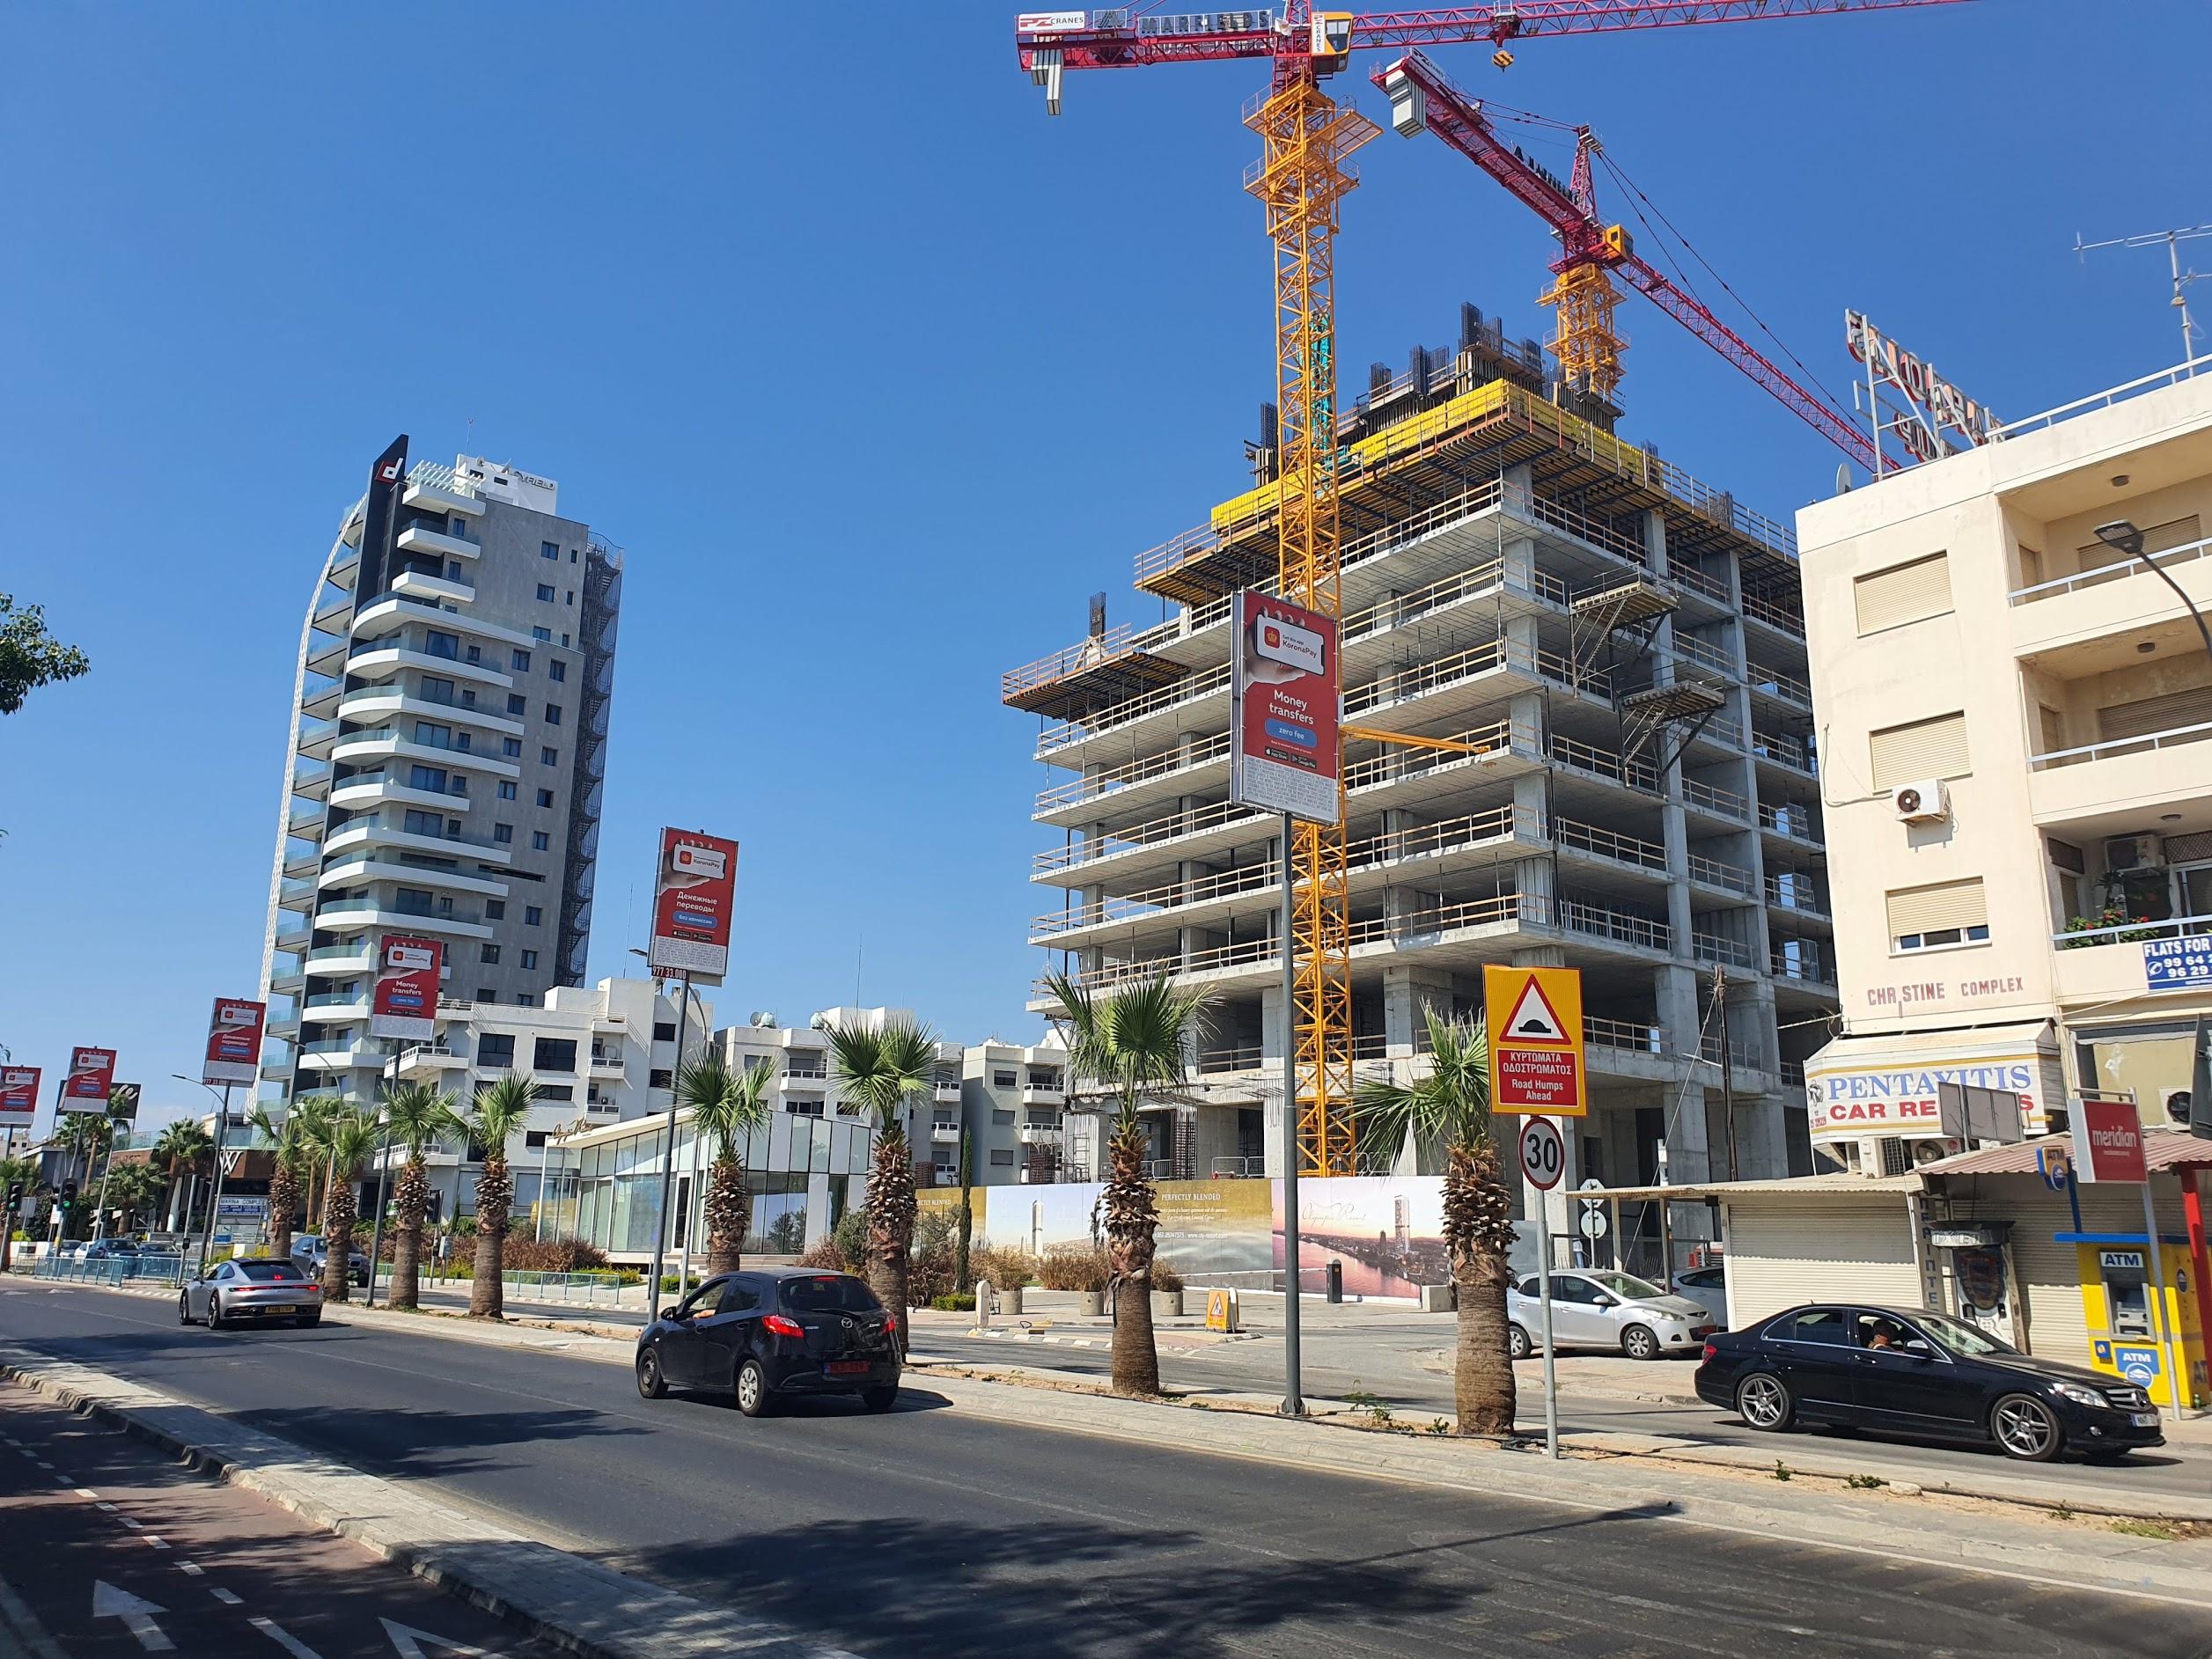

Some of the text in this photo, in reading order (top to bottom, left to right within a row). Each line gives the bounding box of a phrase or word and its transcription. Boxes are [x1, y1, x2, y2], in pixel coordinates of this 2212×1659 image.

[1050, 16, 1084, 25] CRANES
[1282, 640, 1317, 658] KoronaPay
[1274, 689, 1308, 711] Money
[1268, 702, 1314, 725] transfers
[1294, 730, 1304, 739] fee
[694, 858, 720, 870] KoronaPay
[677, 891, 718, 905] Денежные
[676, 901, 715, 914] переводы
[2143, 938, 2211, 958] FLATS FOR
[2164, 958, 2182, 968] 99
[2186, 955, 2205, 965] 64
[2167, 965, 2208, 978] 96 29
[395, 980, 418, 989] Money
[1961, 977, 2024, 997] COMPLEX
[392, 987, 422, 996] transfers
[1510, 1052, 1562, 1063] ΚΥΡΤΩΜΑΤΑ
[1503, 1062, 1572, 1075] ΟΔΟΣΤΡΩΜΑΤΟΣ
[1511, 1079, 1564, 1092] Road Humps
[1525, 1090, 1552, 1101] Ahead
[1830, 1102, 1886, 1120] CAR
[2092, 1126, 2137, 1148] meridian
[1526, 1133, 1558, 1173] 30
[1919, 1198, 1939, 1311] ΠΕΡΙΠΤΕ
[2105, 1254, 2140, 1266] ATM
[2122, 1353, 2151, 1362] ATM
[2193, 1360, 2208, 1384] AT
